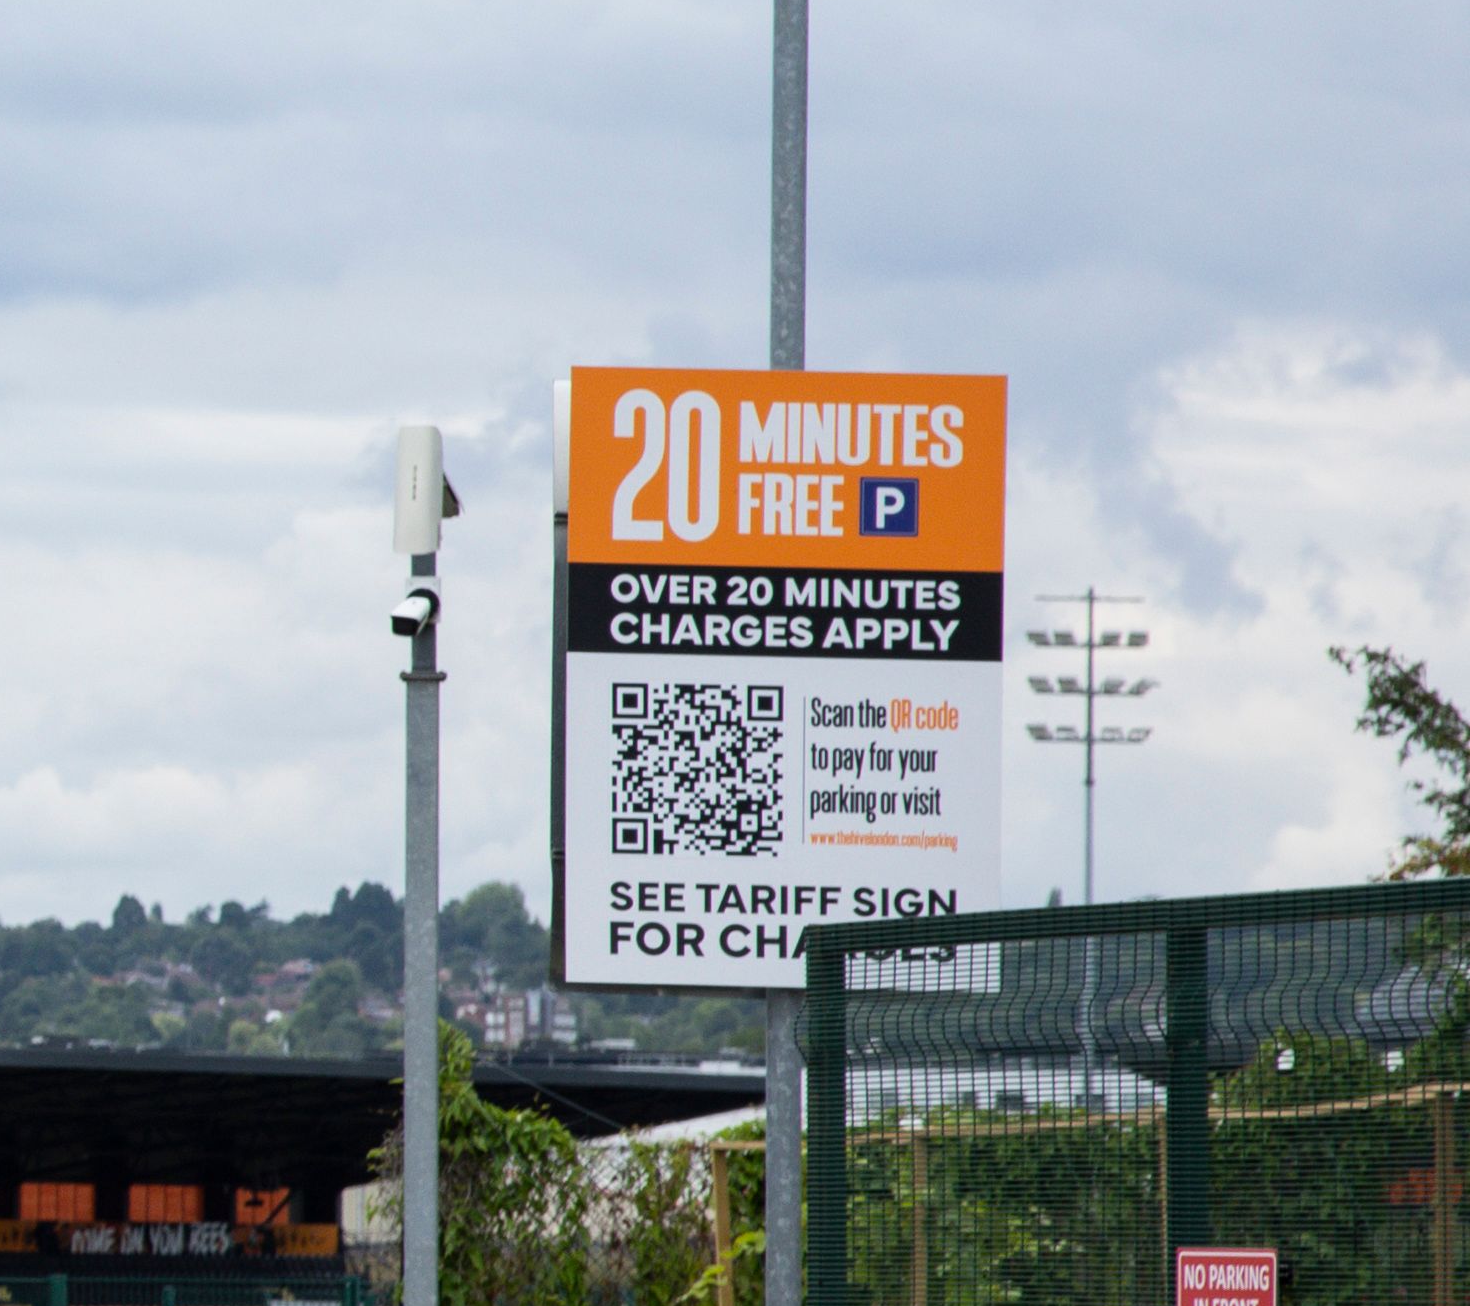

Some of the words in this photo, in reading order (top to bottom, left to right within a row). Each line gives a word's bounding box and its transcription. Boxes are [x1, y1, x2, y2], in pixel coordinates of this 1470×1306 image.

[739, 401, 965, 468] MINUTES
[612, 388, 721, 542] 20
[737, 472, 844, 536] FREE
[875, 486, 906, 529] P
[610, 574, 717, 604] OVER
[726, 576, 774, 606] 20
[784, 578, 962, 611] MINUTES
[610, 612, 813, 647] CHARGES
[822, 617, 960, 651] APPLY
[811, 697, 854, 728] Scan
[859, 698, 887, 729] the
[890, 699, 912, 732] QR
[915, 701, 959, 730] code
[811, 743, 828, 770] to
[832, 747, 865, 779] pay
[869, 741, 894, 772] for
[899, 749, 937, 780] your
[810, 784, 877, 824] parking
[881, 792, 898, 815] or
[903, 786, 941, 816] visit
[810, 831, 958, 853] www.thehivelondon.com/parking
[610, 881, 685, 912] SEE
[696, 883, 842, 915] TARIFF
[853, 887, 957, 917] SIGN
[610, 921, 705, 957] FOR
[1184, 1263, 1206, 1290] NO
[1209, 1264, 1270, 1292] PARKING
